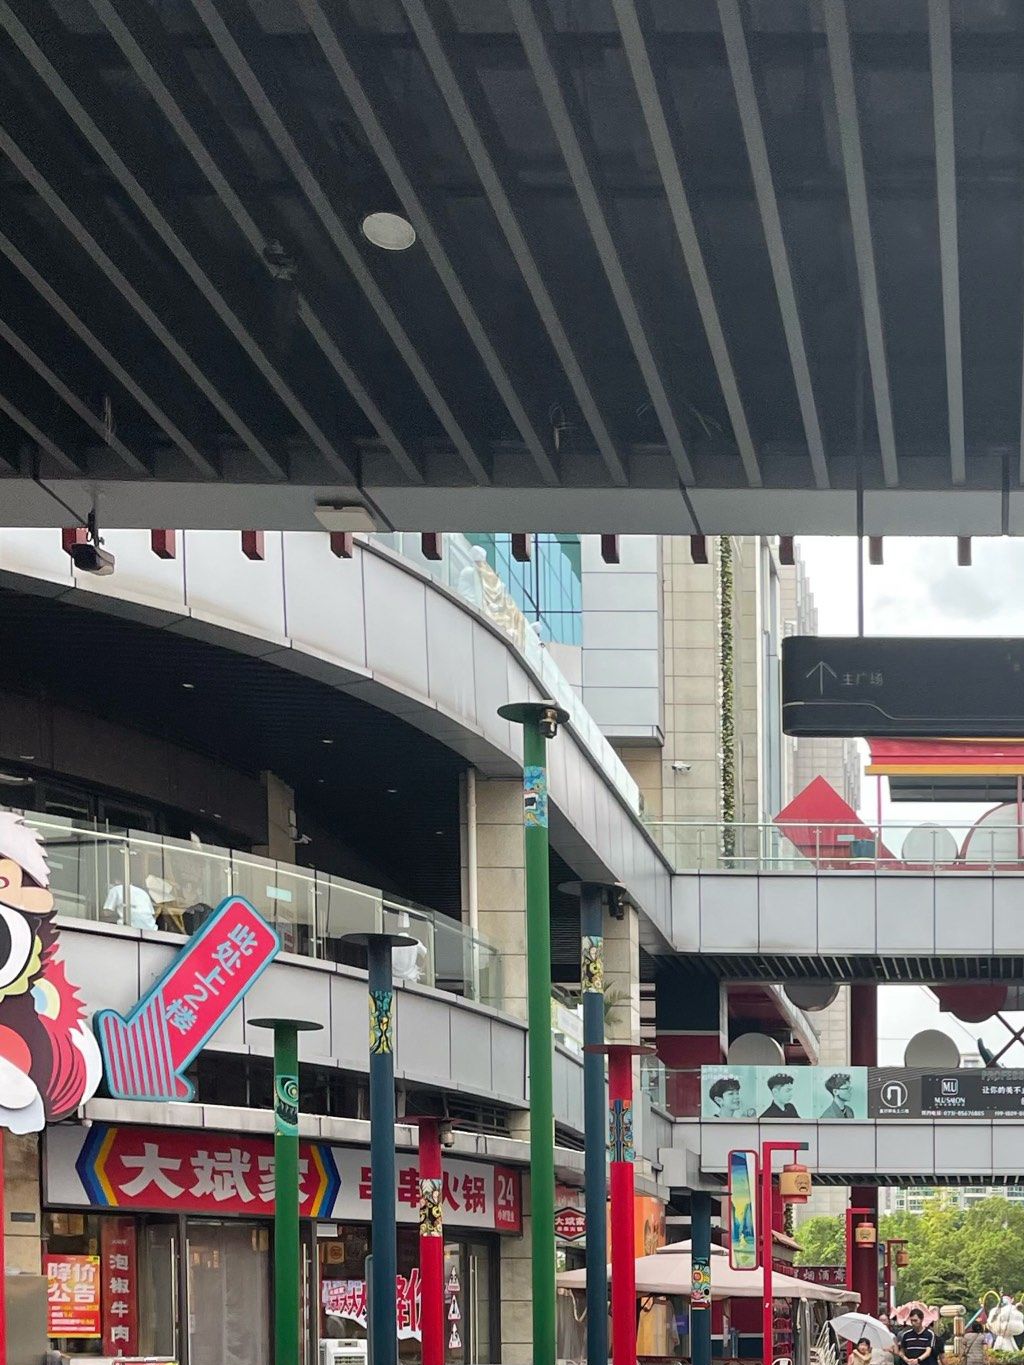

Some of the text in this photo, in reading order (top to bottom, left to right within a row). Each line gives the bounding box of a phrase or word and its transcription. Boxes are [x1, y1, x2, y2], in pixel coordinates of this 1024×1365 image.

[839, 671, 884, 686] 主广场
[165, 923, 259, 1036] 此处上2楼
[497, 1175, 515, 1207] 24
[47, 1262, 97, 1283] 降价
[47, 1282, 97, 1304] 公告
[109, 1254, 130, 1357] 泡椒牛肉
